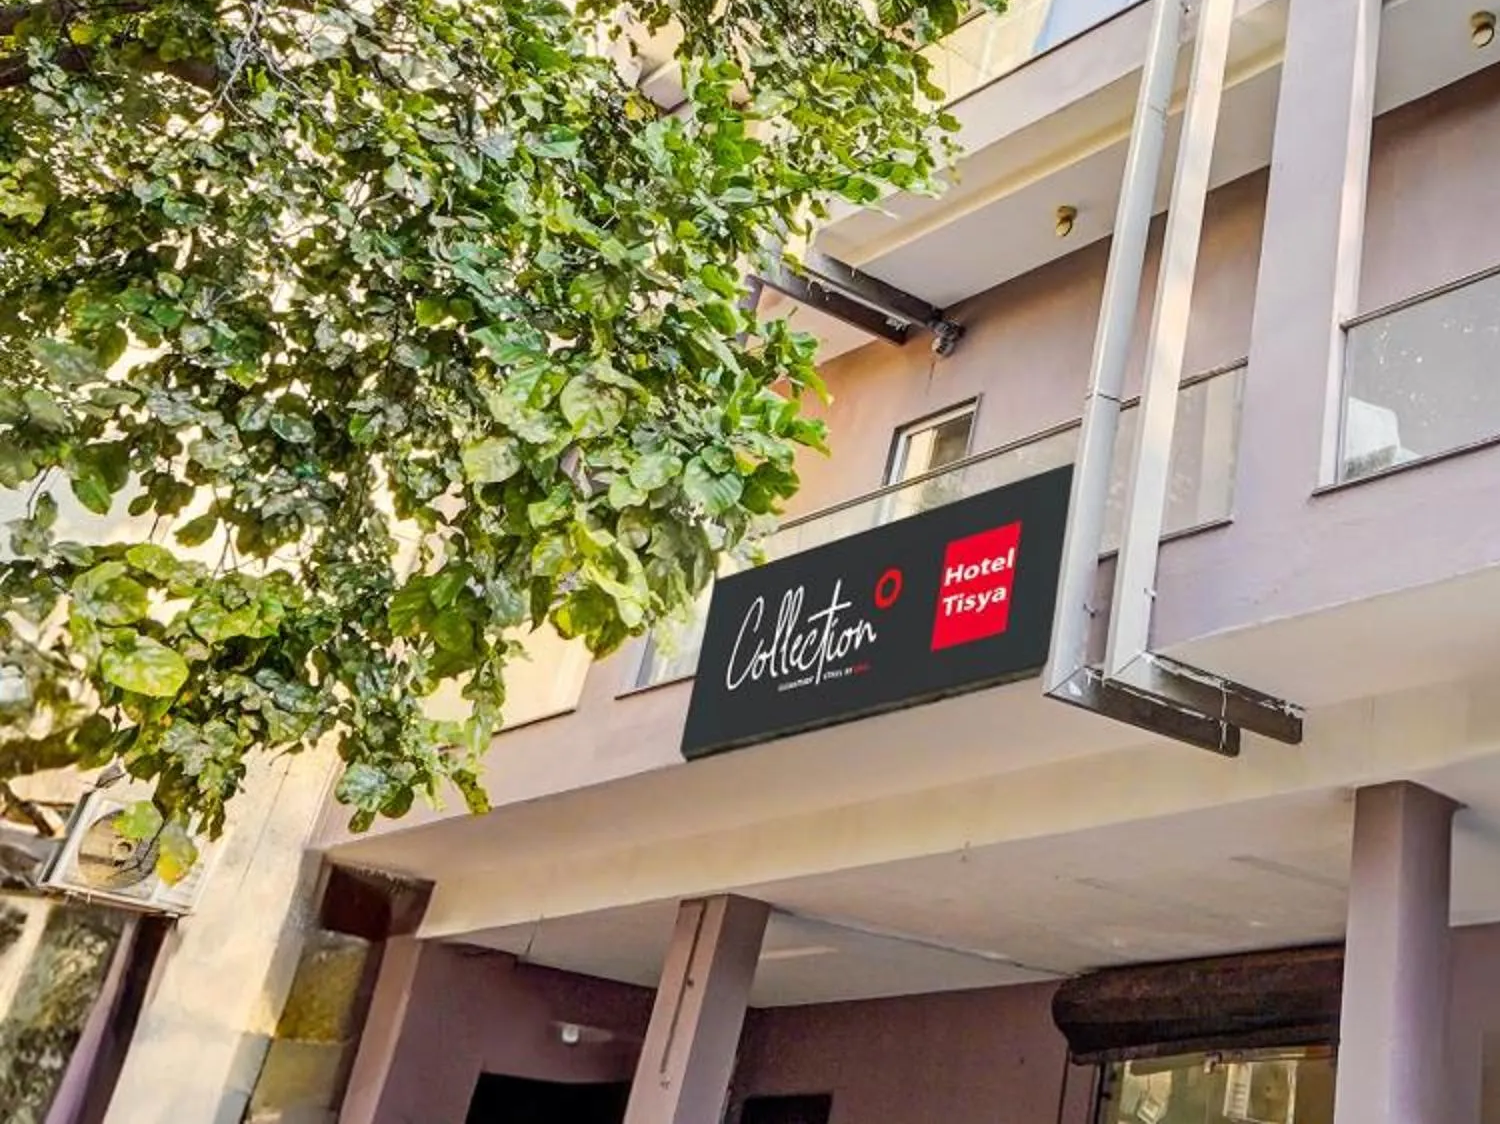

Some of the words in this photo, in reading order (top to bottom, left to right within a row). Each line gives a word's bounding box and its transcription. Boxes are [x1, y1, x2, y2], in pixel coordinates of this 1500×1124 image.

[944, 547, 1015, 587] Hotel
[943, 586, 1007, 617] Tisya
[726, 579, 877, 691] Collection
